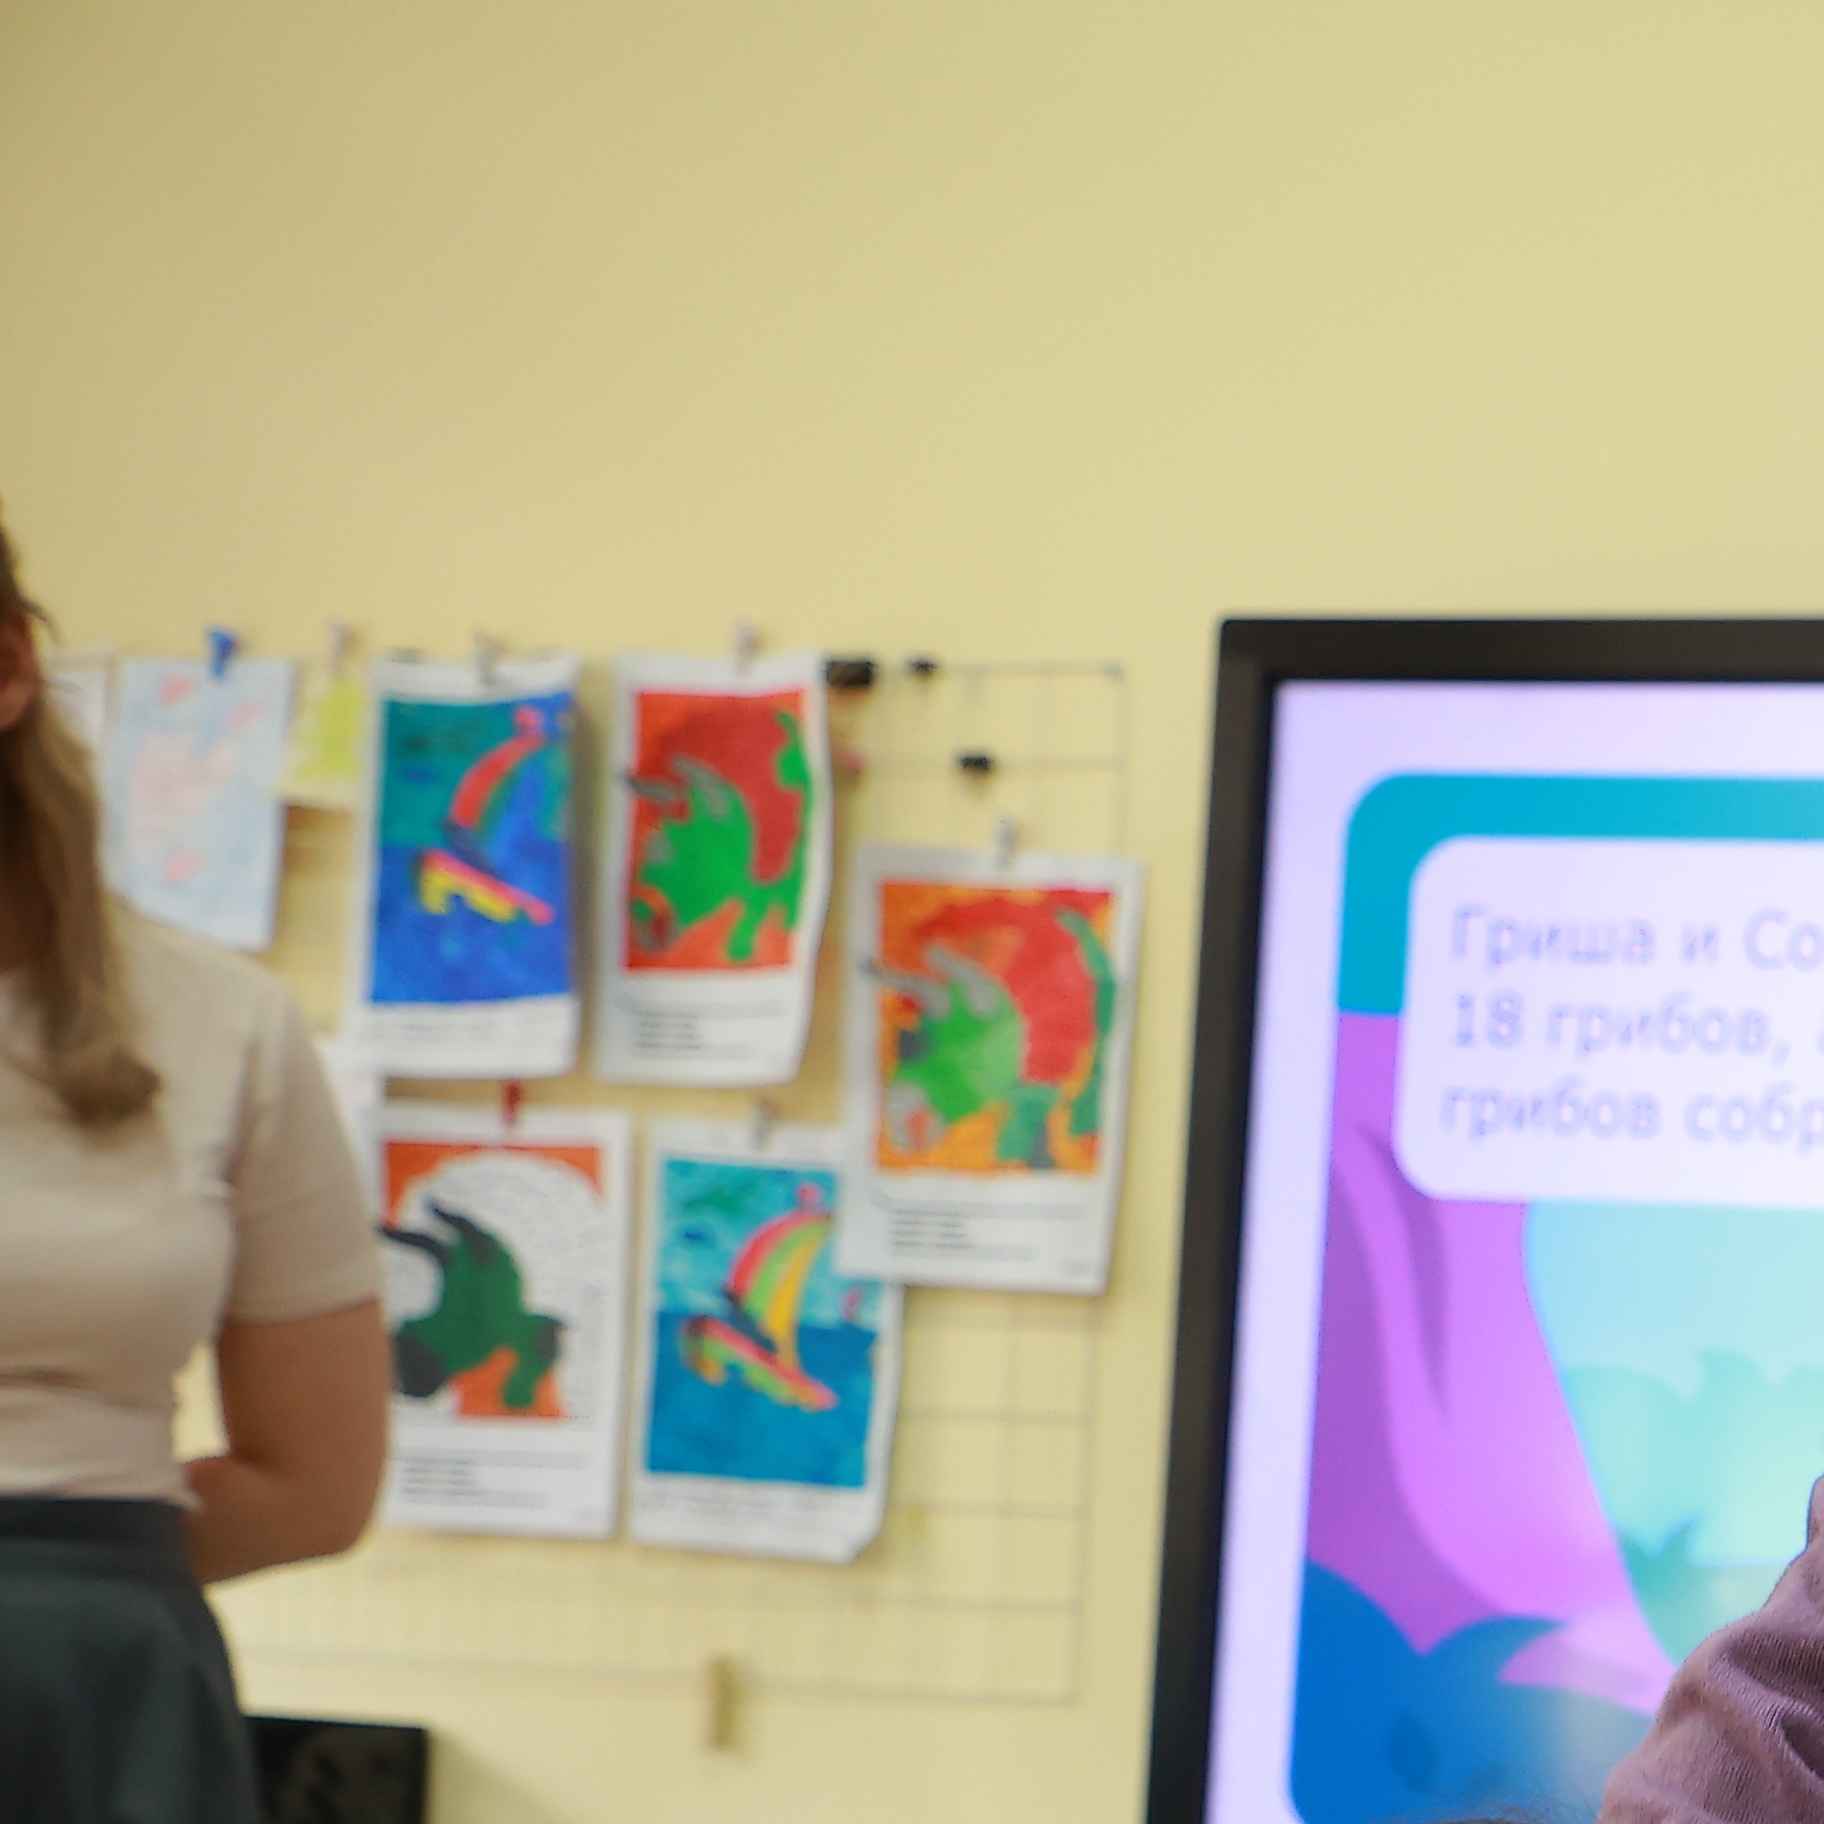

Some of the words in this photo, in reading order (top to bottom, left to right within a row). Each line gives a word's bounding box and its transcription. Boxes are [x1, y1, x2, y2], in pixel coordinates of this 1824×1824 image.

[1453, 902, 1655, 975] Гриша
[1682, 922, 1720, 966] и
[1453, 990, 1523, 1050] 18
[1548, 990, 1790, 1068] грибов,
[1440, 1072, 1662, 1150] грибов
